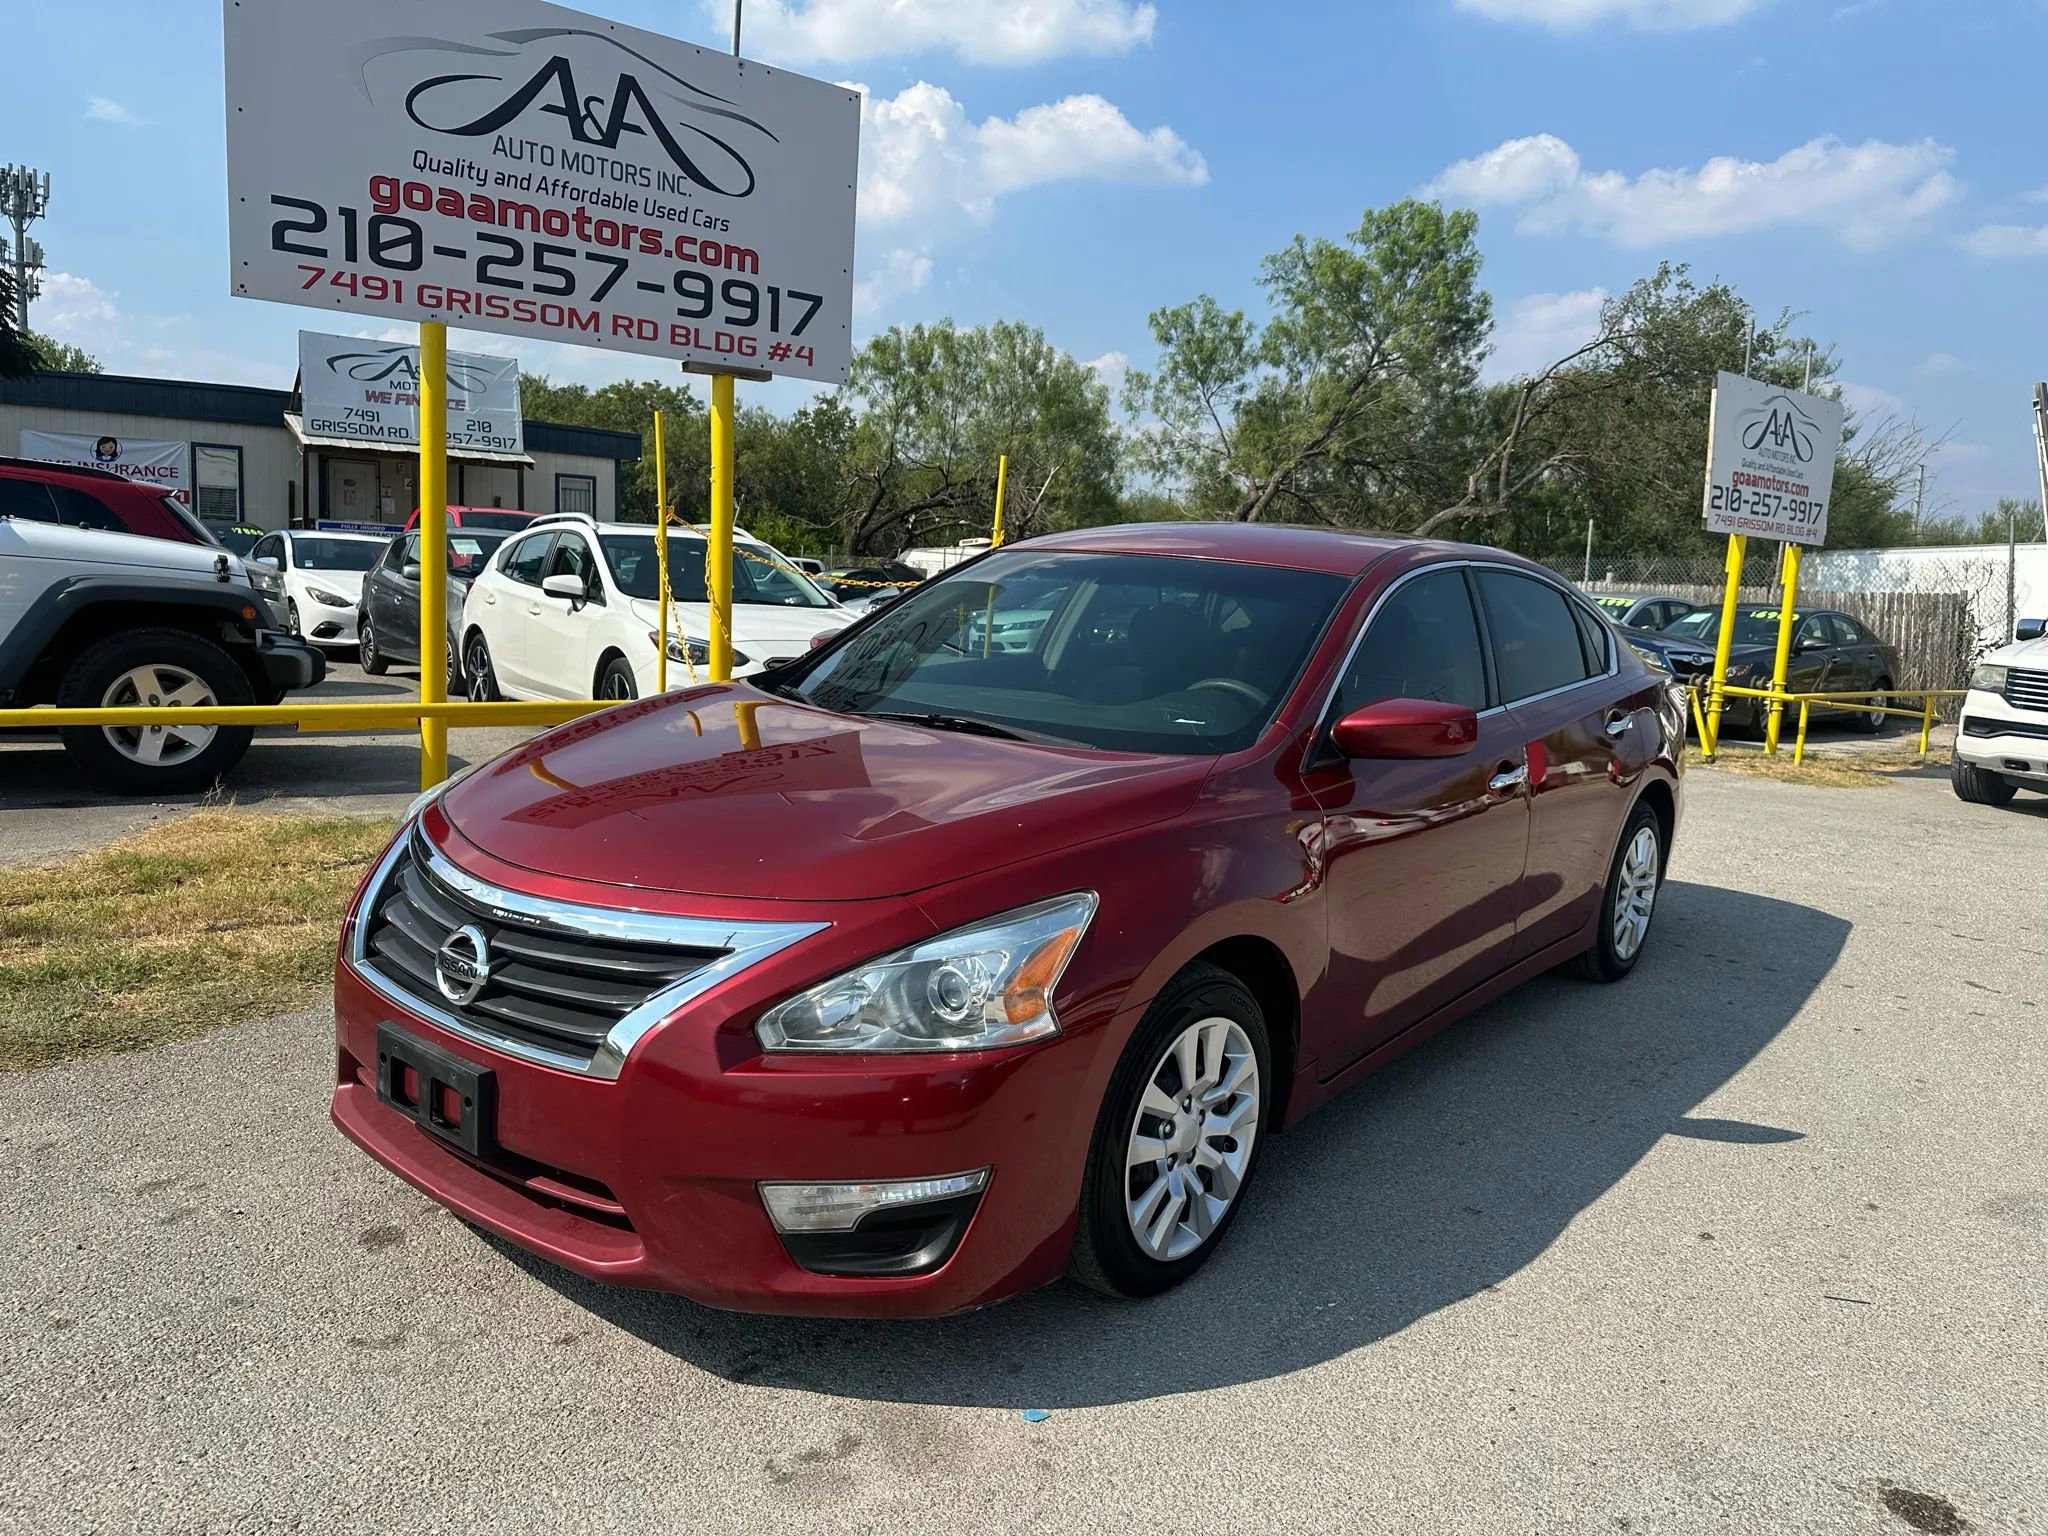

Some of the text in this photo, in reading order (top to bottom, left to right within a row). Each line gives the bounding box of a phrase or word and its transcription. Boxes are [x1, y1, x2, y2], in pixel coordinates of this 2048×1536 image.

[492, 134, 693, 198] AUTO MOTORS INC.
[412, 149, 731, 232] Quality and Affordable Used Cars
[368, 174, 760, 276] goaamotors.com
[270, 193, 824, 338] 210-257-9917
[297, 263, 815, 367] 7491 GRISSOM RD BLDG #4
[365, 389, 466, 412] WE FINCE
[343, 407, 380, 423] 7491
[466, 419, 492, 433] 210
[311, 418, 413, 440] GRISSOM RD.
[1732, 471, 1809, 498] goaamotors.com
[1711, 484, 1823, 525] 210-257-9917
[1714, 513, 1818, 539] 7491 GRISSOM RD BLDG #4
[438, 953, 478, 979] ISSAN
